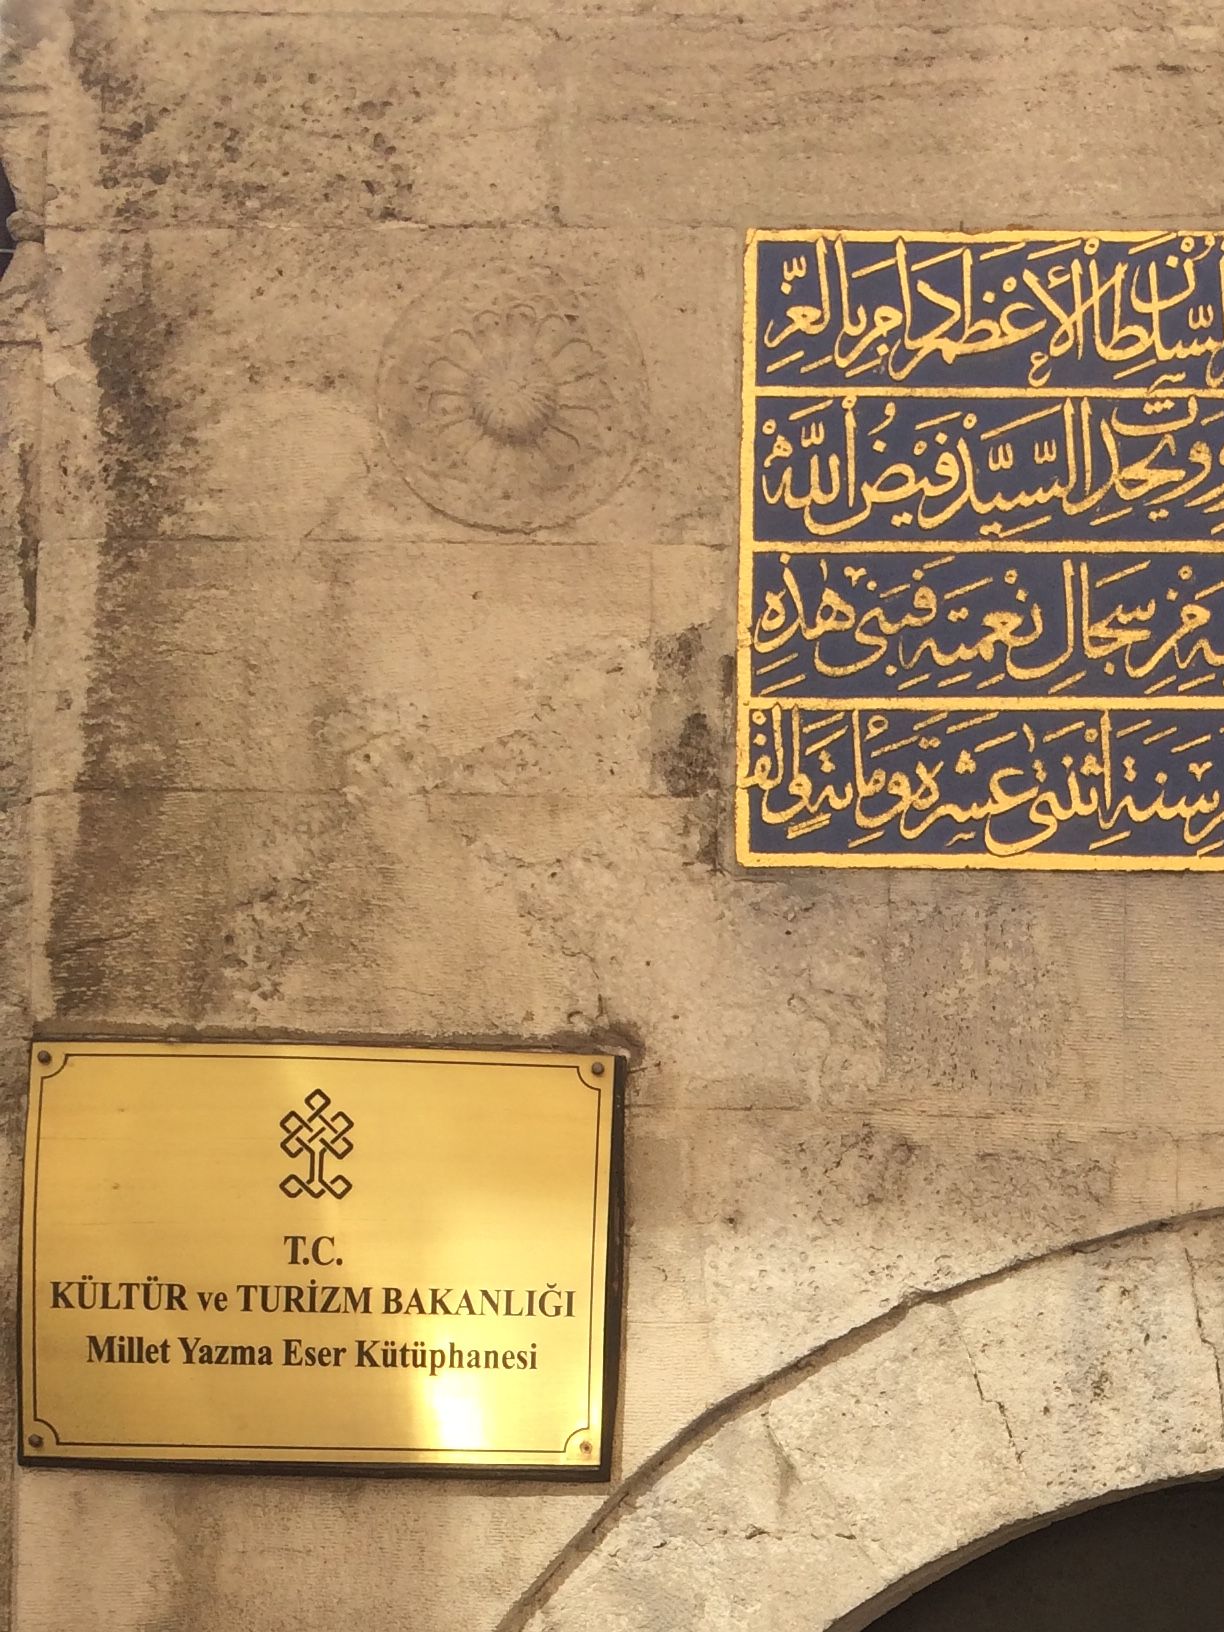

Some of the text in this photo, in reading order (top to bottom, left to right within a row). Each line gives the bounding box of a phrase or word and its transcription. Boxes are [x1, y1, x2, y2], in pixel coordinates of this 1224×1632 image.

[283, 1235, 343, 1267] T.C.
[49, 1274, 575, 1318] KÜLTÜR ve TURİZM BAKANLIĞI
[86, 1334, 538, 1376] Millet Yazma Eser Kütüphanesi
